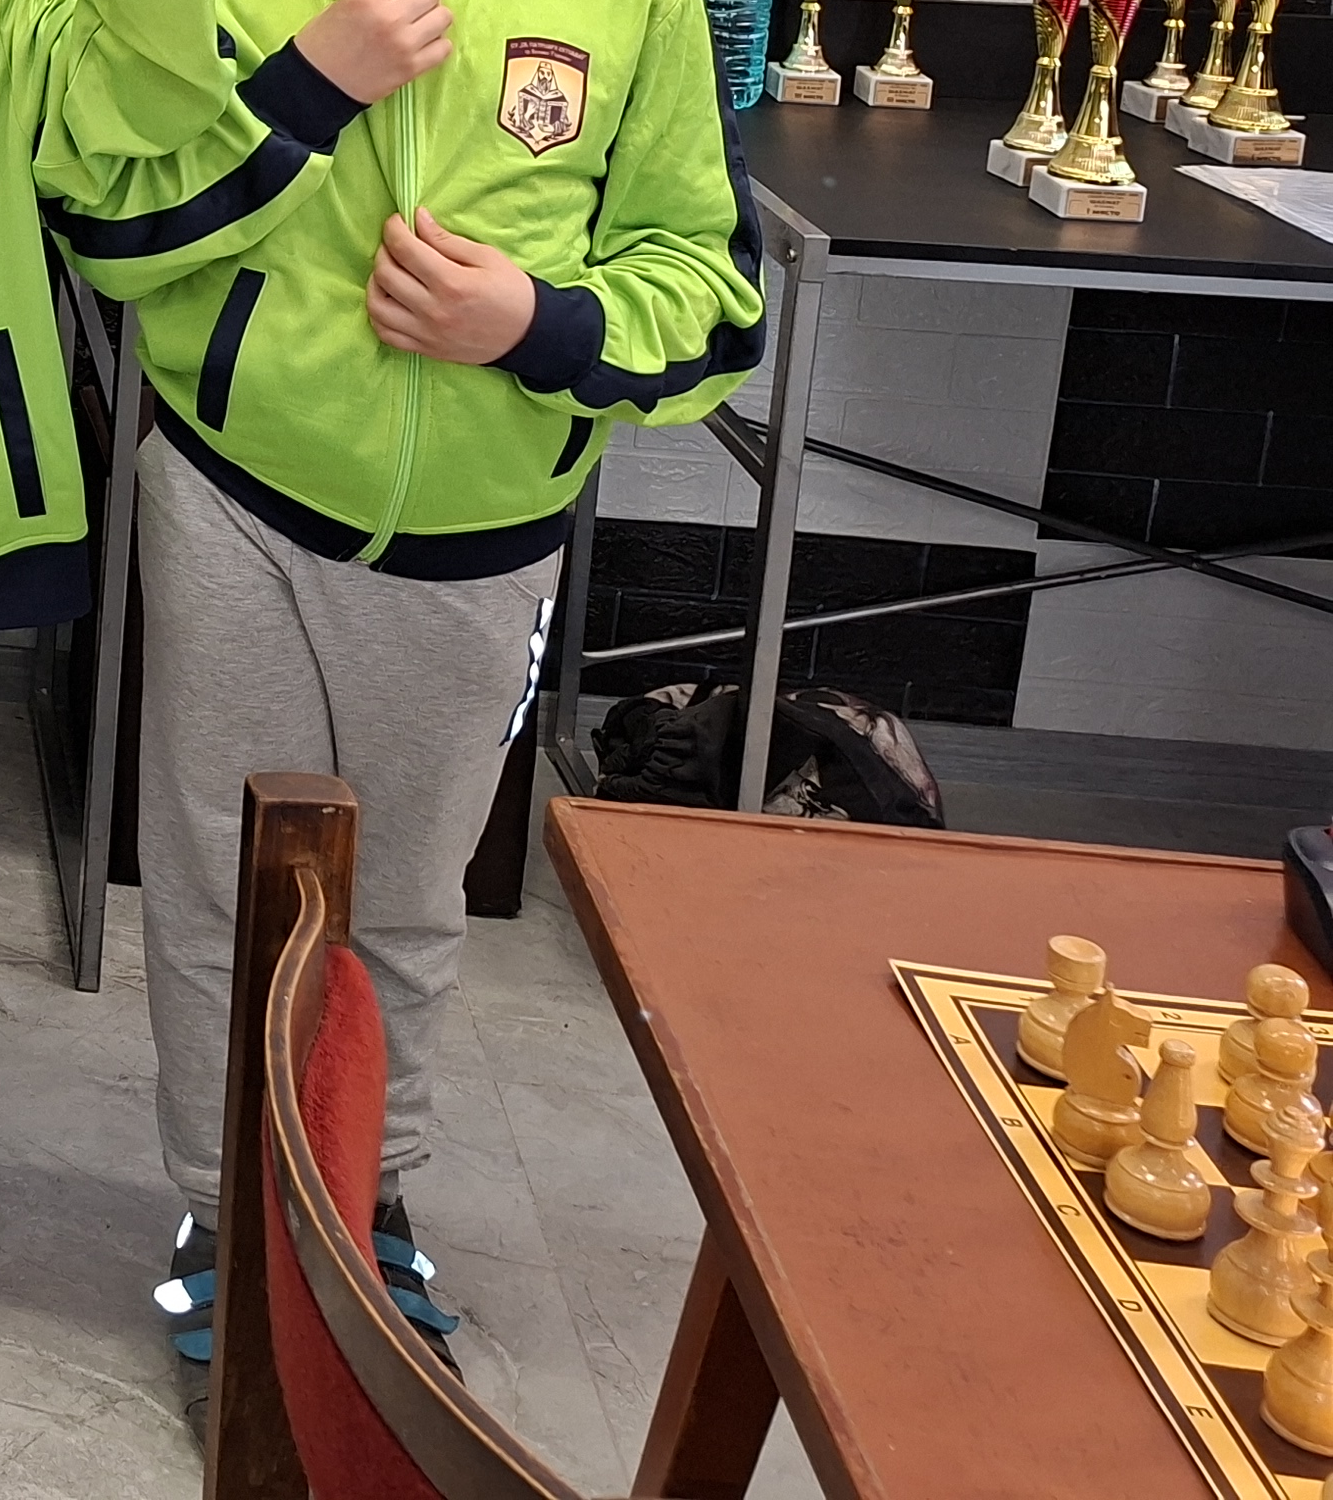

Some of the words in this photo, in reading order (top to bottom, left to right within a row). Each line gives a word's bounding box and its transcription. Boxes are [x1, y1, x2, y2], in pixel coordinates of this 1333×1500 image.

[1161, 1010, 1182, 1020] 2
[1308, 1026, 1330, 1035] 3
[948, 1034, 970, 1045] A
[1001, 1116, 1024, 1128] B
[1058, 1204, 1081, 1217] C
[1117, 1299, 1143, 1313] D
[1187, 1404, 1215, 1420] E
